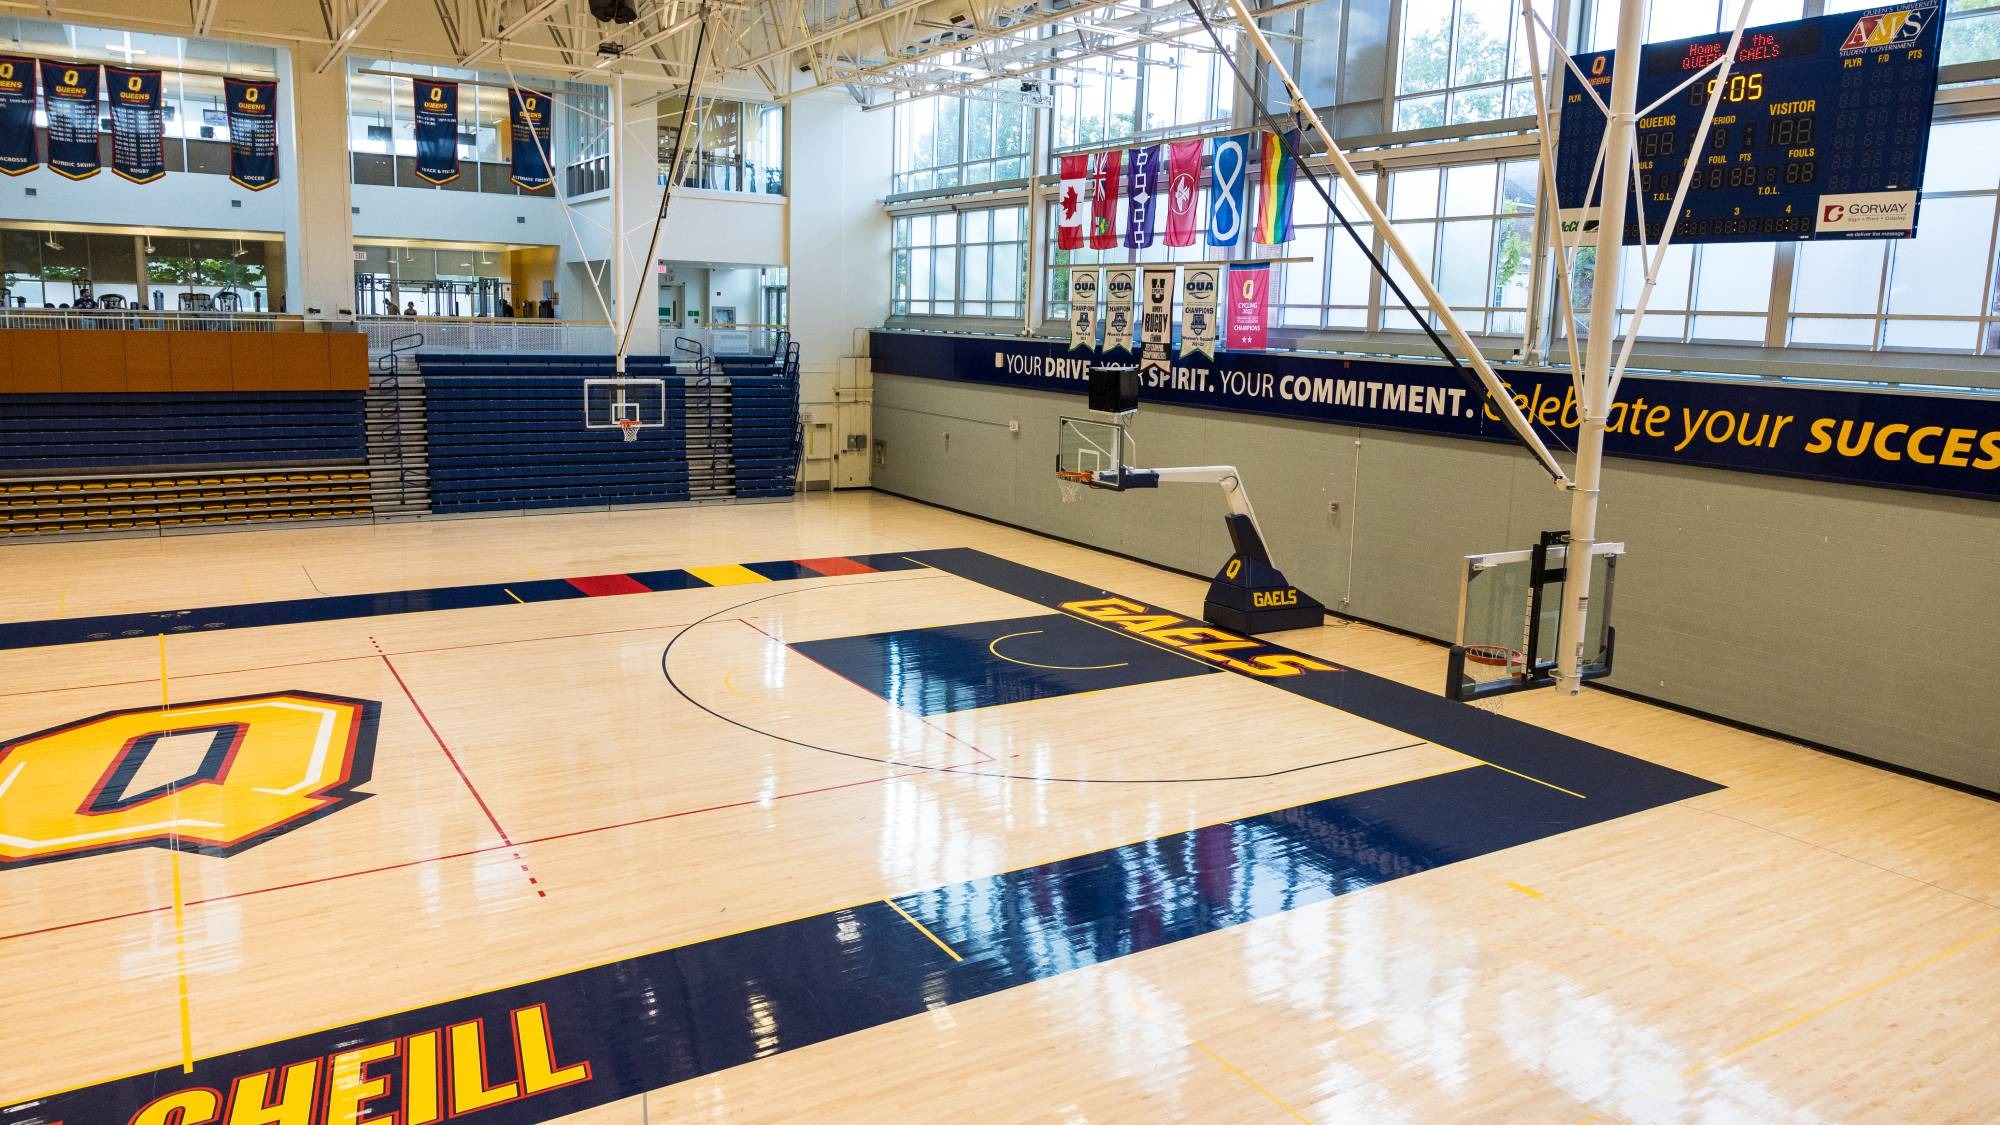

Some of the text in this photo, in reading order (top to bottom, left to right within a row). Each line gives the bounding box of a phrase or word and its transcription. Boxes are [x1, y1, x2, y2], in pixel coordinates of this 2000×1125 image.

[1863, 0, 1938, 16] QUEEN'S UNIVERSITY
[1848, 11, 1922, 45] AMS
[1689, 43, 1721, 56] Home
[1753, 33, 1774, 47] the
[1840, 42, 1916, 57] STUDENT GOVERNMENT
[1908, 49, 1923, 59] PTS
[1682, 44, 1781, 69] QUEEN GAELS
[1844, 58, 1862, 68] PLYR
[1587, 77, 1612, 86] UEENS
[55, 85, 87, 94] QUEENS
[120, 91, 150, 100] QUEENS
[1568, 95, 1582, 103] PLYR
[238, 102, 266, 111] QUEENS
[423, 101, 448, 109] QUEENS
[1769, 100, 1816, 116] VISITOR
[519, 111, 542, 119] QEENS
[1639, 115, 1677, 129] QUEENS
[1739, 153, 1752, 162] PTS
[1788, 148, 1815, 158] FOULS
[1708, 155, 1728, 164] FOUL
[1758, 186, 1780, 195] T.O.L.
[1653, 192, 1673, 201] T.O.L.
[1734, 207, 1740, 216] 3
[1785, 204, 1792, 213] 4
[1848, 202, 1908, 215] GORWAY
[1685, 210, 1692, 218] 2
[1881, 230, 1905, 238] message
[1074, 282, 1096, 291] OUA
[1109, 282, 1132, 291] OUA
[1186, 281, 1213, 291] OUA
[1185, 306, 1214, 314] CHAMPIONS
[1144, 313, 1168, 333] RUGBY
[1006, 353, 1042, 376] YOUR
[1045, 357, 1090, 380] DRIVE
[1220, 369, 1274, 399] YOUR
[1279, 374, 1474, 419] COMMITMENT.
[1484, 382, 1671, 438] Celebate
[1674, 406, 1794, 452] your
[1226, 559, 1242, 581] Q
[1253, 589, 1298, 608] GAELS
[1057, 597, 1347, 678] GAELS
